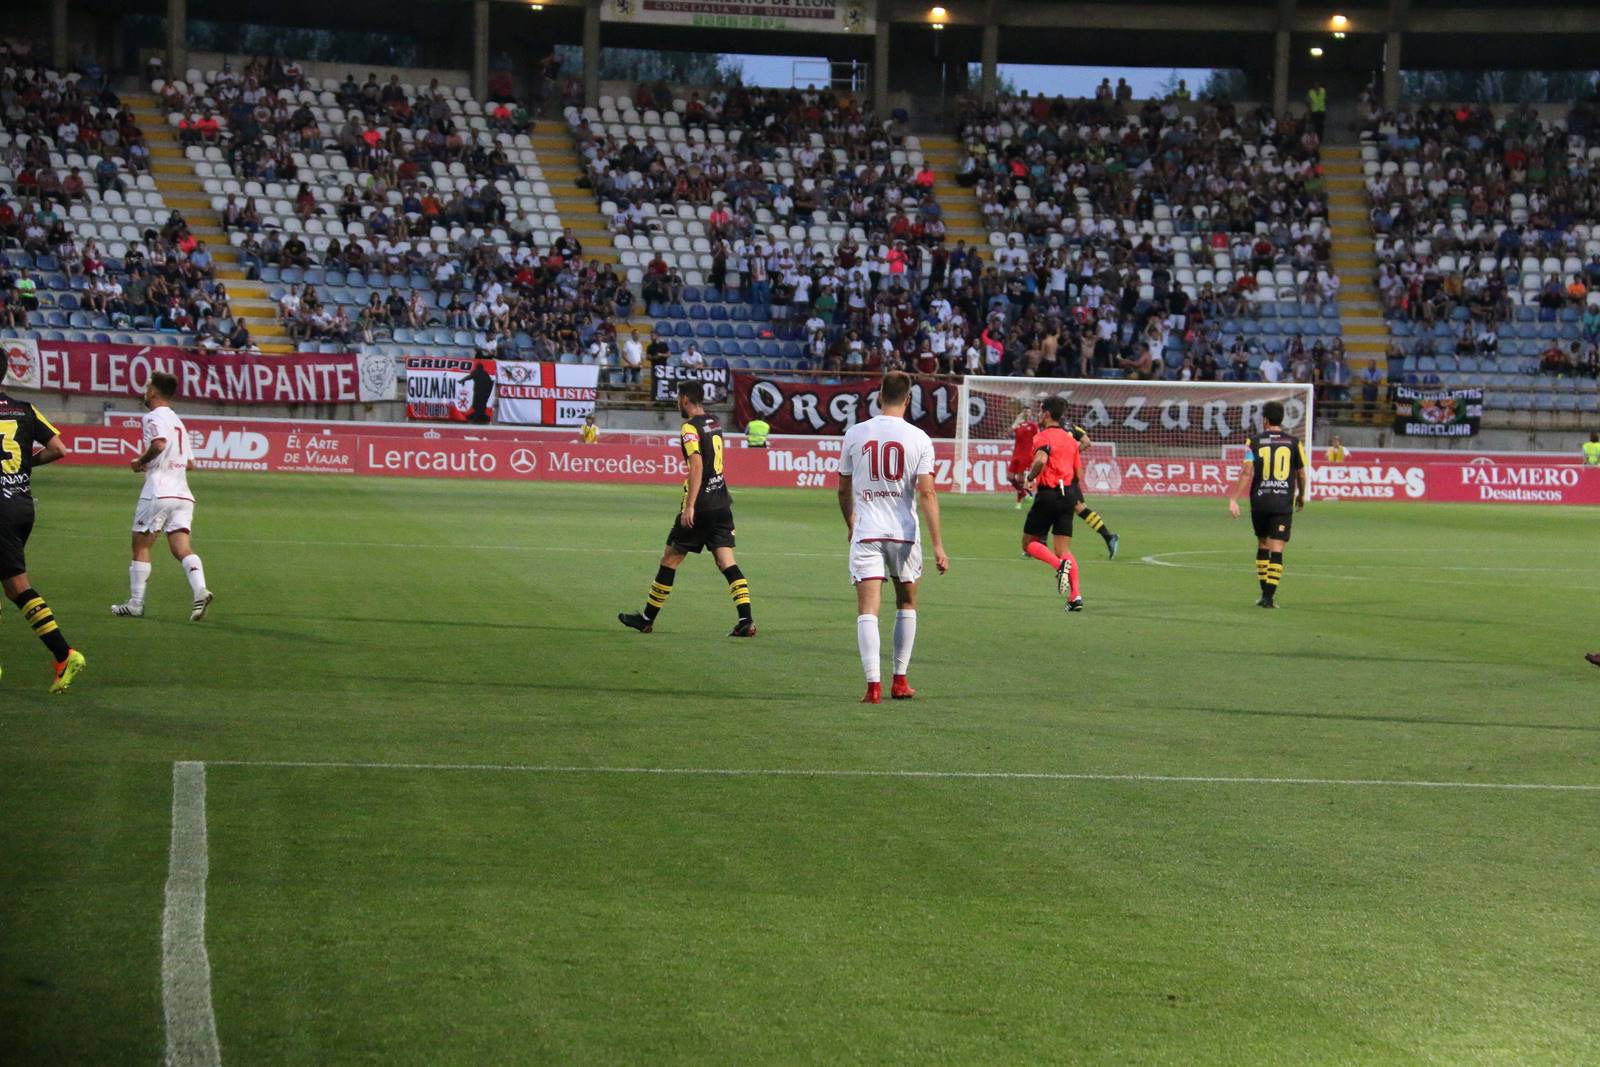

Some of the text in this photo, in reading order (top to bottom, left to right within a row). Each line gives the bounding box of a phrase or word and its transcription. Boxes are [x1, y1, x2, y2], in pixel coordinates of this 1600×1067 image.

[41, 351, 80, 391] EL
[181, 360, 356, 401] RAMPANTE
[407, 358, 473, 371] GRUPO
[407, 373, 457, 399] GUZMÁN
[500, 387, 598, 400] CULTURALISTAS
[368, 443, 497, 472] Lercauto
[548, 451, 689, 475] Mercedes-Be
[767, 450, 842, 473] Maho
[862, 440, 905, 481] 10
[1258, 446, 1291, 481] 10
[796, 473, 827, 488] SIN
[1125, 461, 1242, 484] ASPIRE
[1311, 466, 1426, 498] MERIAS
[1461, 466, 1579, 487] PALMERO
[1141, 482, 1230, 494] ACADEMY
[1310, 484, 1395, 498] UTOCARES
[1480, 485, 1563, 500] Desatascos
